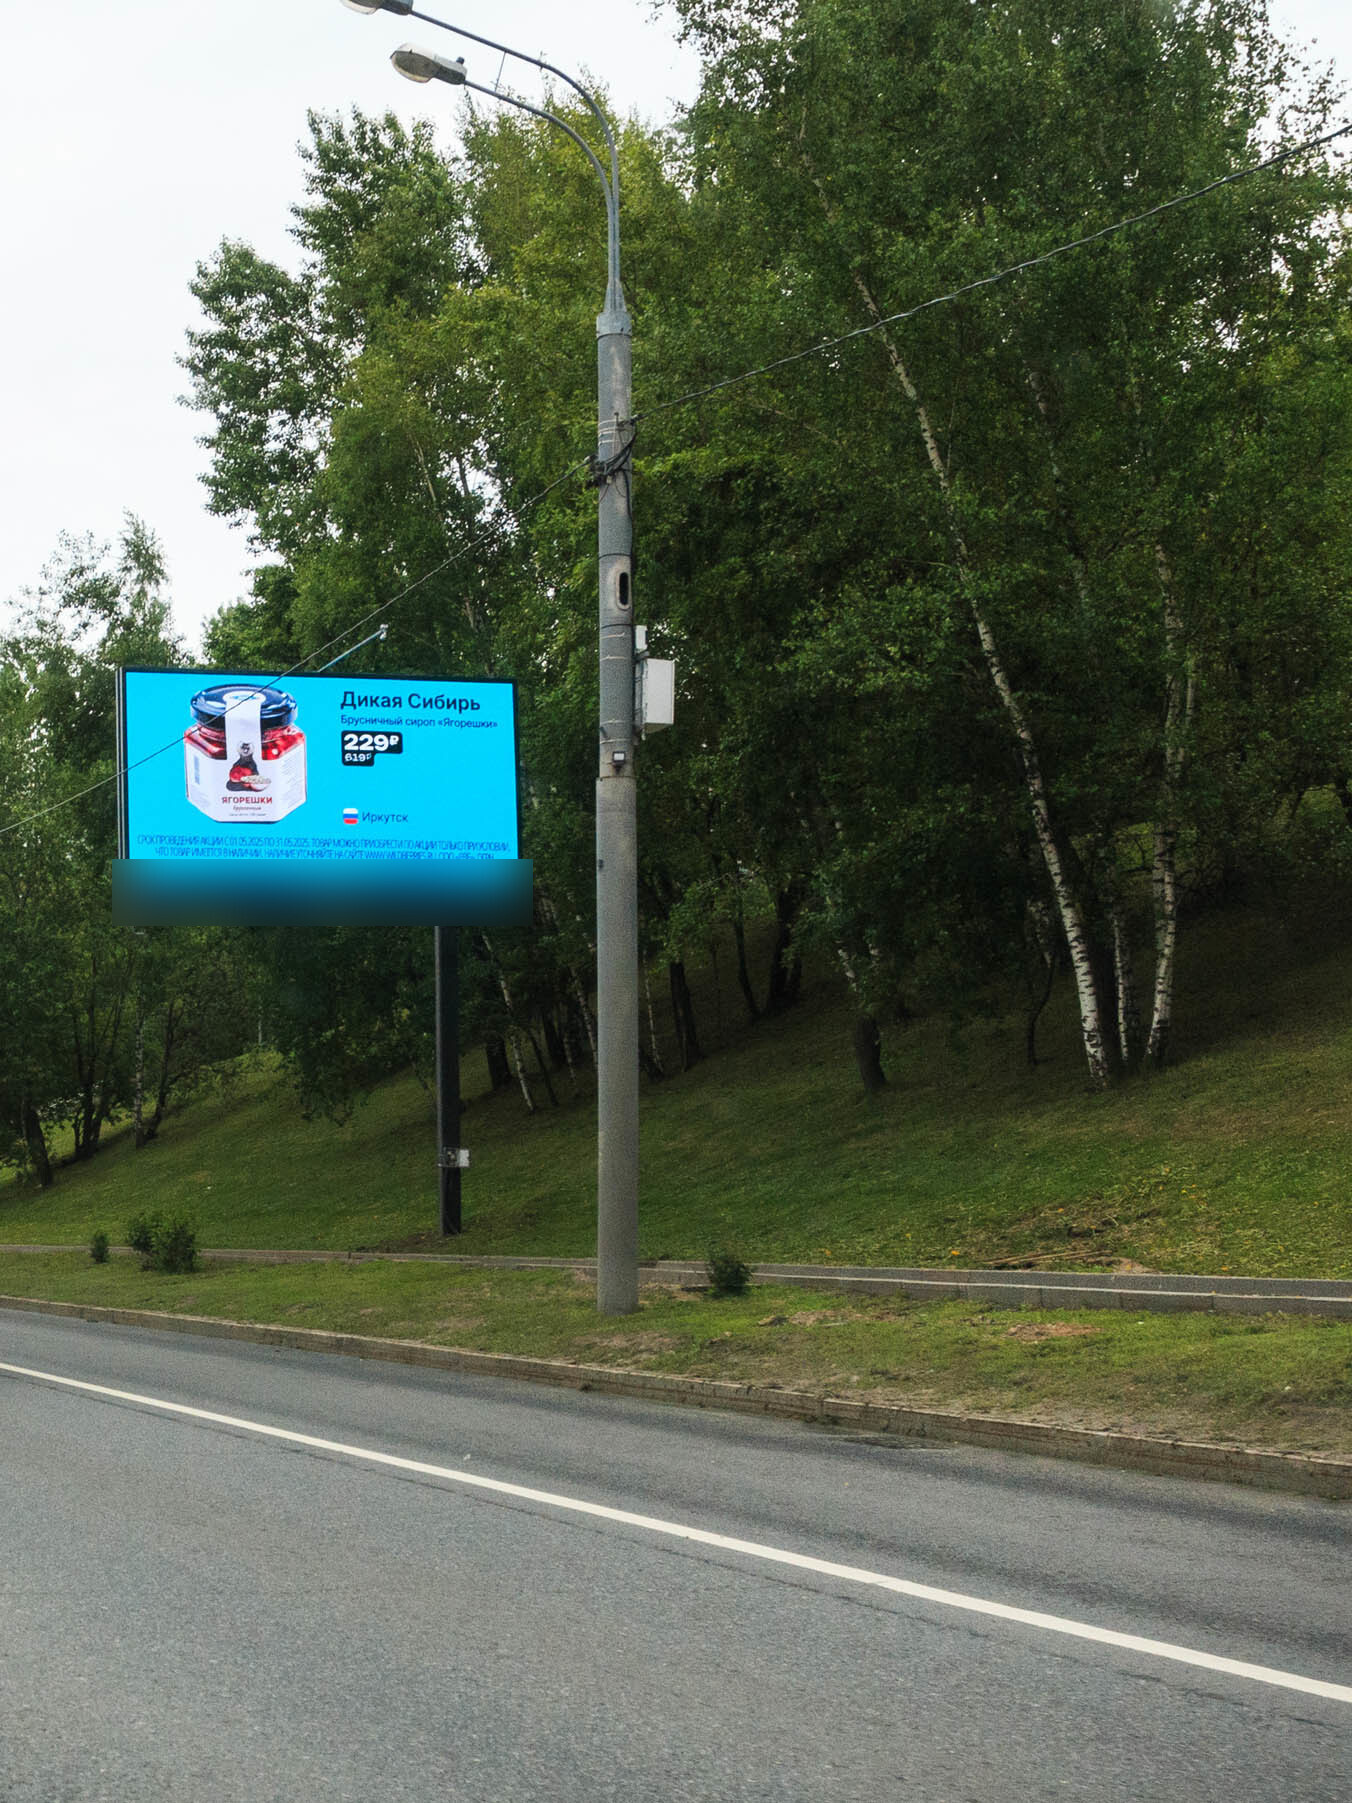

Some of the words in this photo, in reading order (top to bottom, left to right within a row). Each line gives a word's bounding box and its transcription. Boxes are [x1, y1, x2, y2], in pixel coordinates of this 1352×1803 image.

[340, 691, 402, 710] Дикая
[408, 693, 481, 714] Сибирь
[340, 715, 403, 726] Брусничный
[405, 719, 436, 727] сироп
[437, 718, 498, 728] «Ягорешки»
[221, 796, 273, 804] ЯГОРЕШКИ
[361, 811, 409, 824] Иркутск
